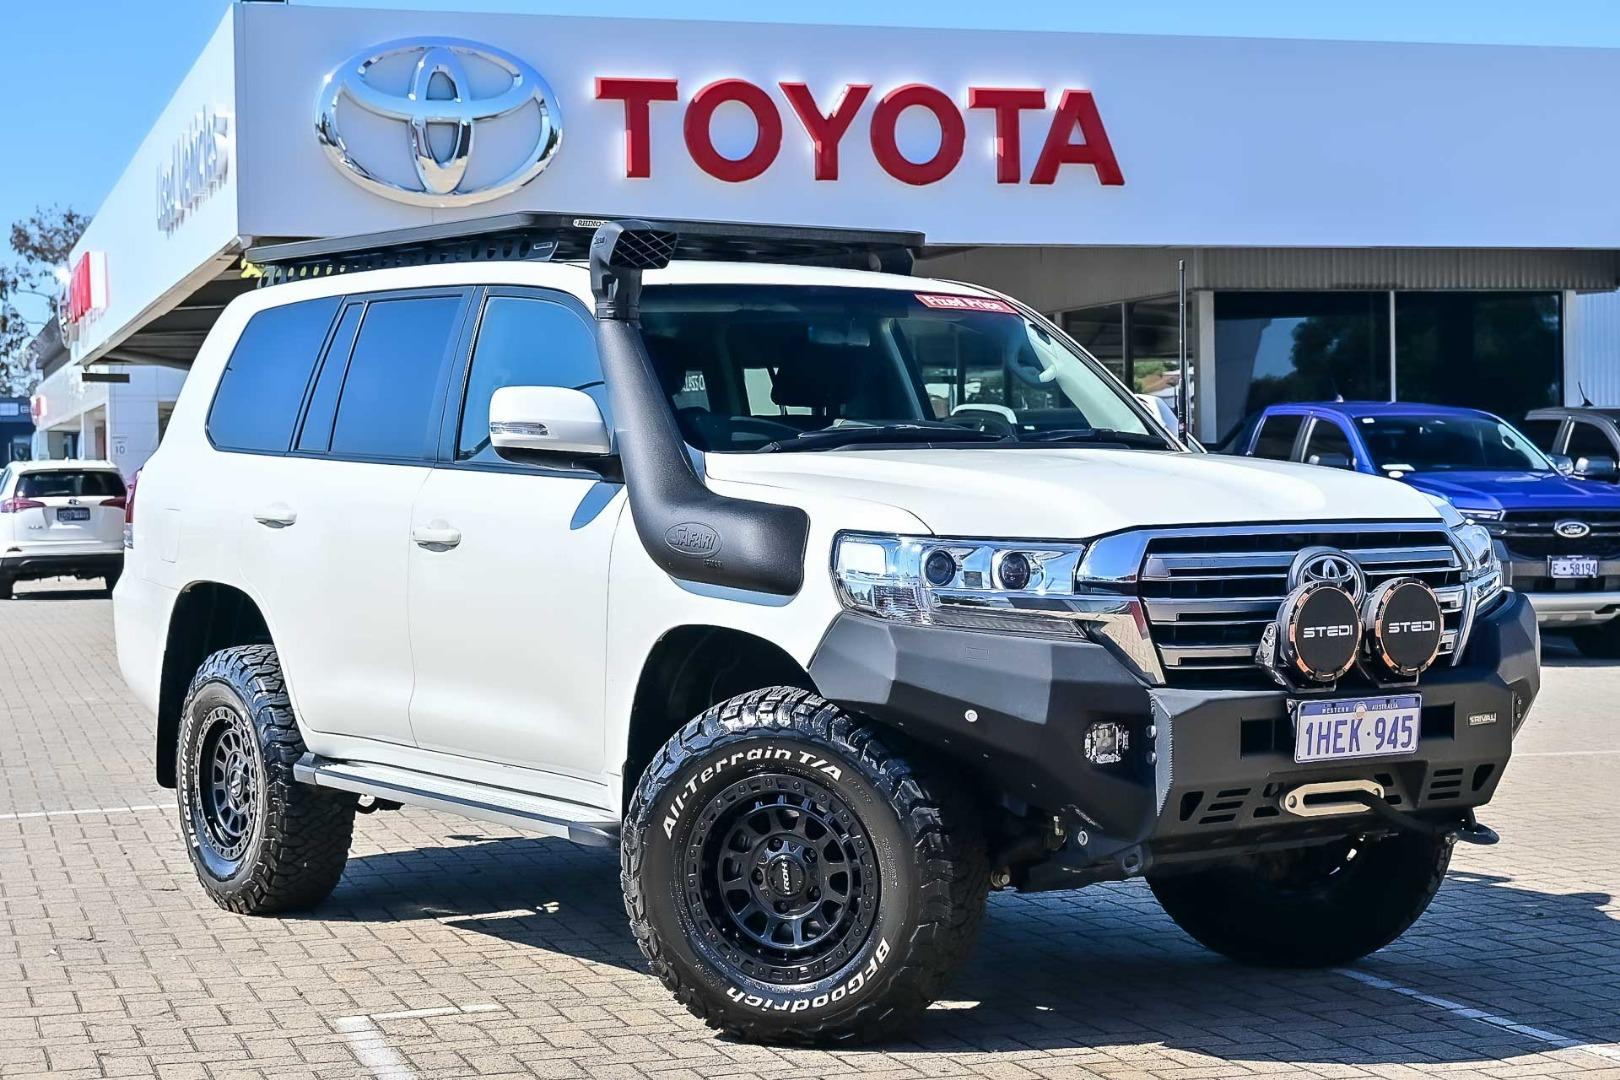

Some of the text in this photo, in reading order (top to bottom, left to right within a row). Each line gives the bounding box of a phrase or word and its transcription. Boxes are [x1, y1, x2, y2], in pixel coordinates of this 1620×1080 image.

[594, 76, 1125, 187] TOYOTA
[922, 295, 1004, 311] Fixed Price
[669, 527, 717, 550] SAFARI
[1303, 624, 1353, 638] STEDI
[1388, 620, 1436, 634] STEDI
[1322, 703, 1399, 714] WESTERN AUSTRALIA
[662, 745, 843, 840] All-Terrain T/A
[726, 936, 891, 1014] BFGoodrich
